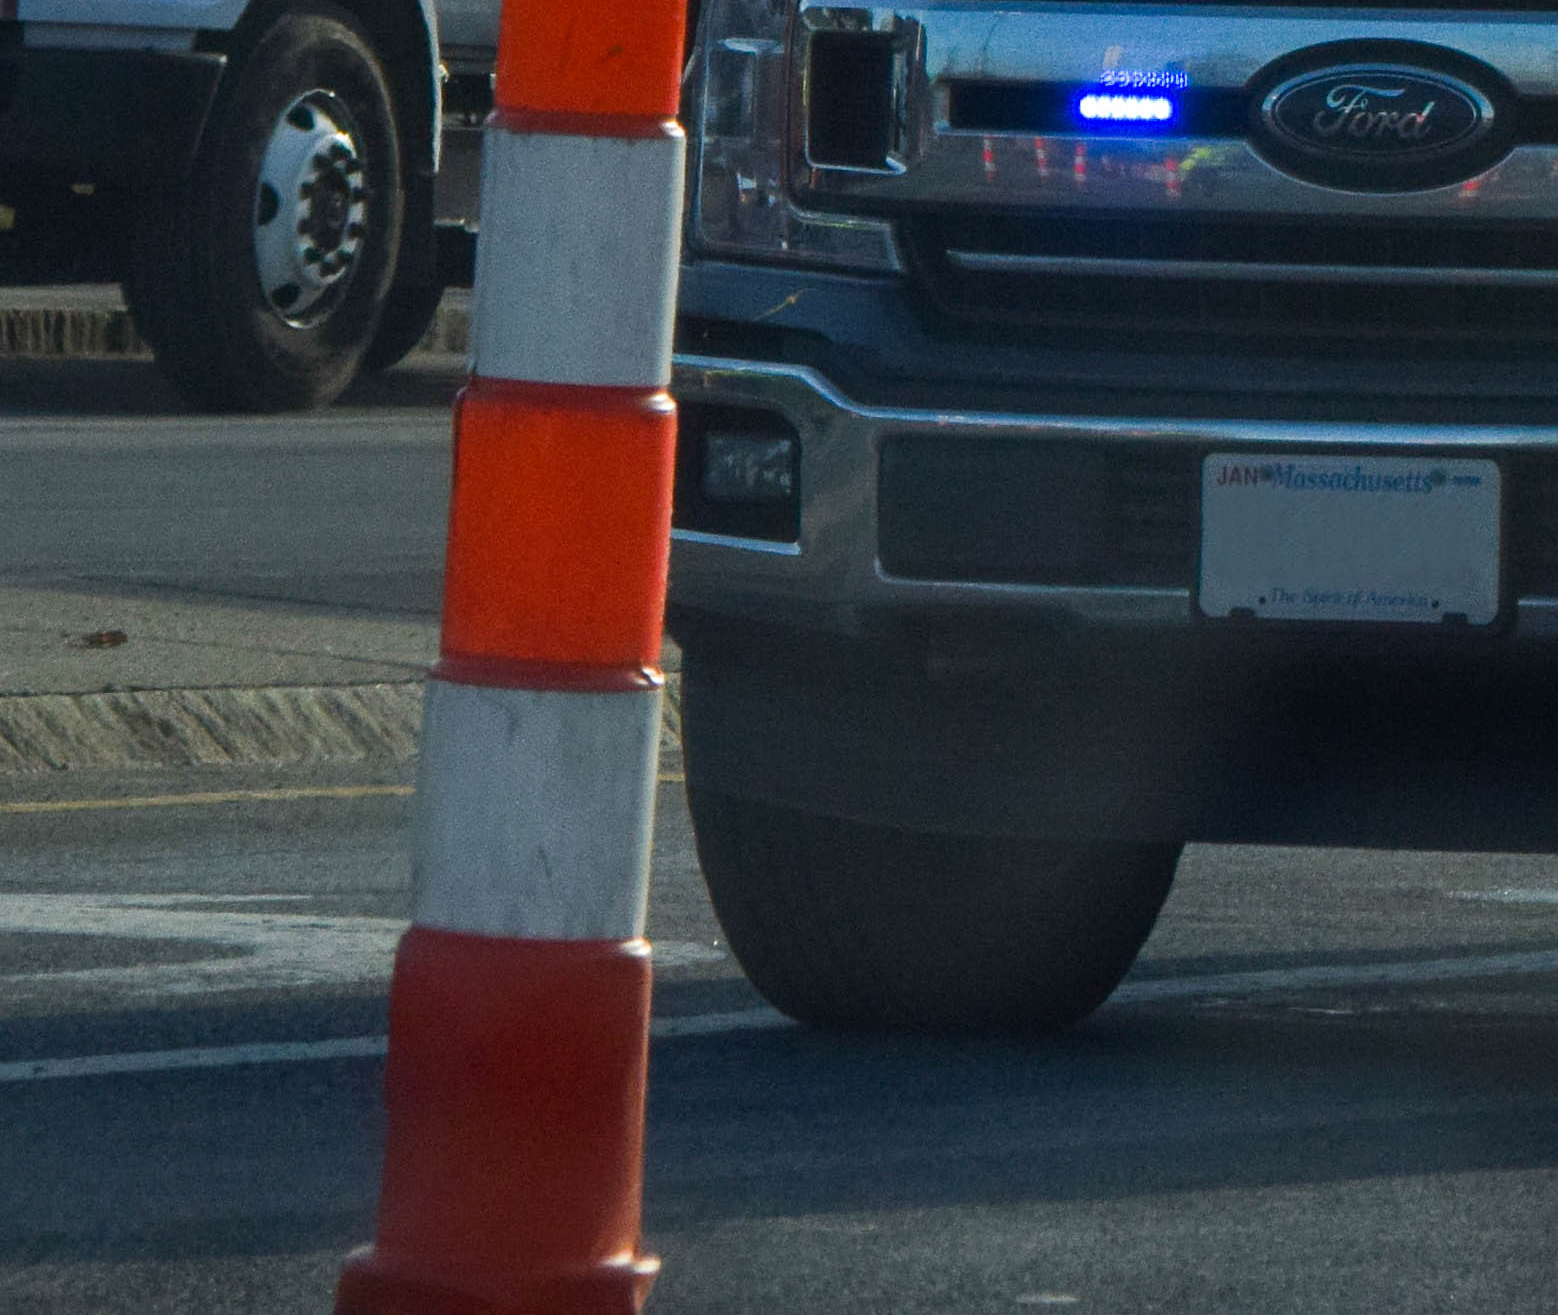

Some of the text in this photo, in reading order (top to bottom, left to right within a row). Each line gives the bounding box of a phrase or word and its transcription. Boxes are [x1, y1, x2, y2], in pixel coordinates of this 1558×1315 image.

[1313, 84, 1436, 136] Ford
[1216, 465, 1259, 487] JAN
[1273, 463, 1434, 494] Massachusetts
